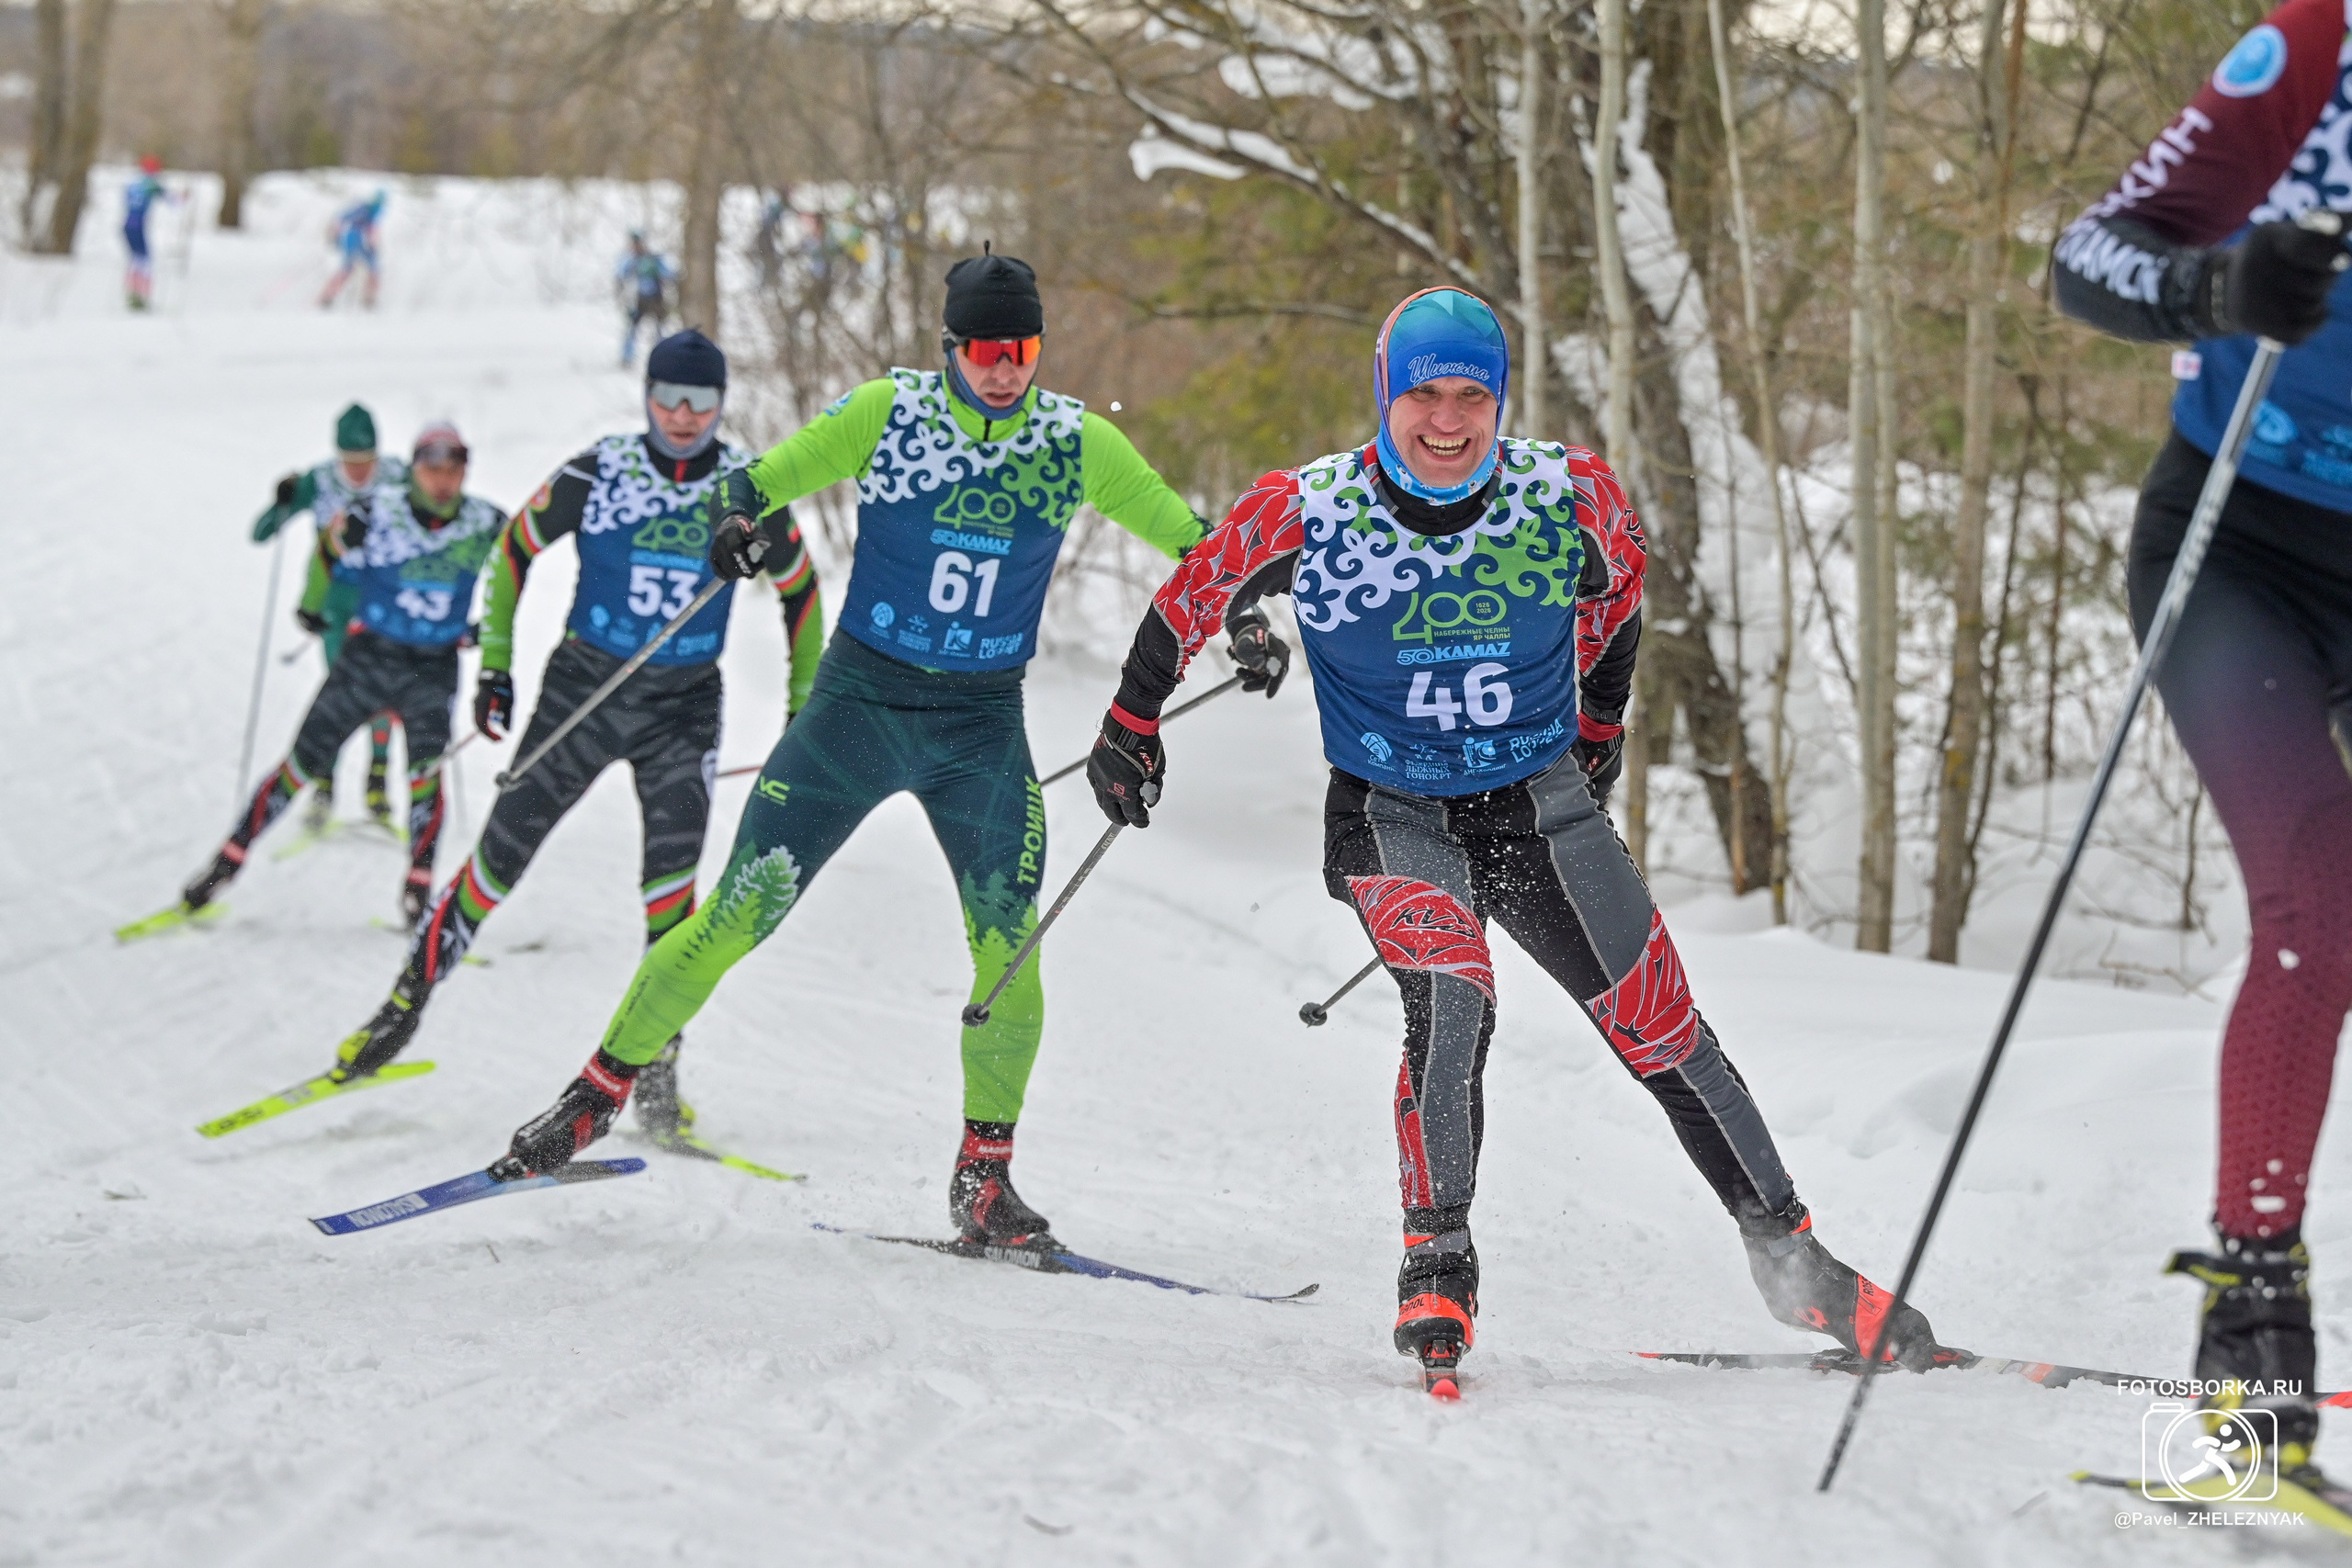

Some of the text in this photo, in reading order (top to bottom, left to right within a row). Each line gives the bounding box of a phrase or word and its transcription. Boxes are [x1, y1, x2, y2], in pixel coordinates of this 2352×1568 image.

[395, 587, 452, 622] 43
[628, 564, 700, 621] 53
[928, 551, 1001, 617] 61
[1392, 589, 1507, 645] 400
[1433, 628, 1483, 637] НАБЕРЕЖНЫЕ
[1434, 642, 1511, 661] KAMAZ
[1406, 662, 1513, 731] 46
[1406, 773, 1440, 781] ГОНОК
